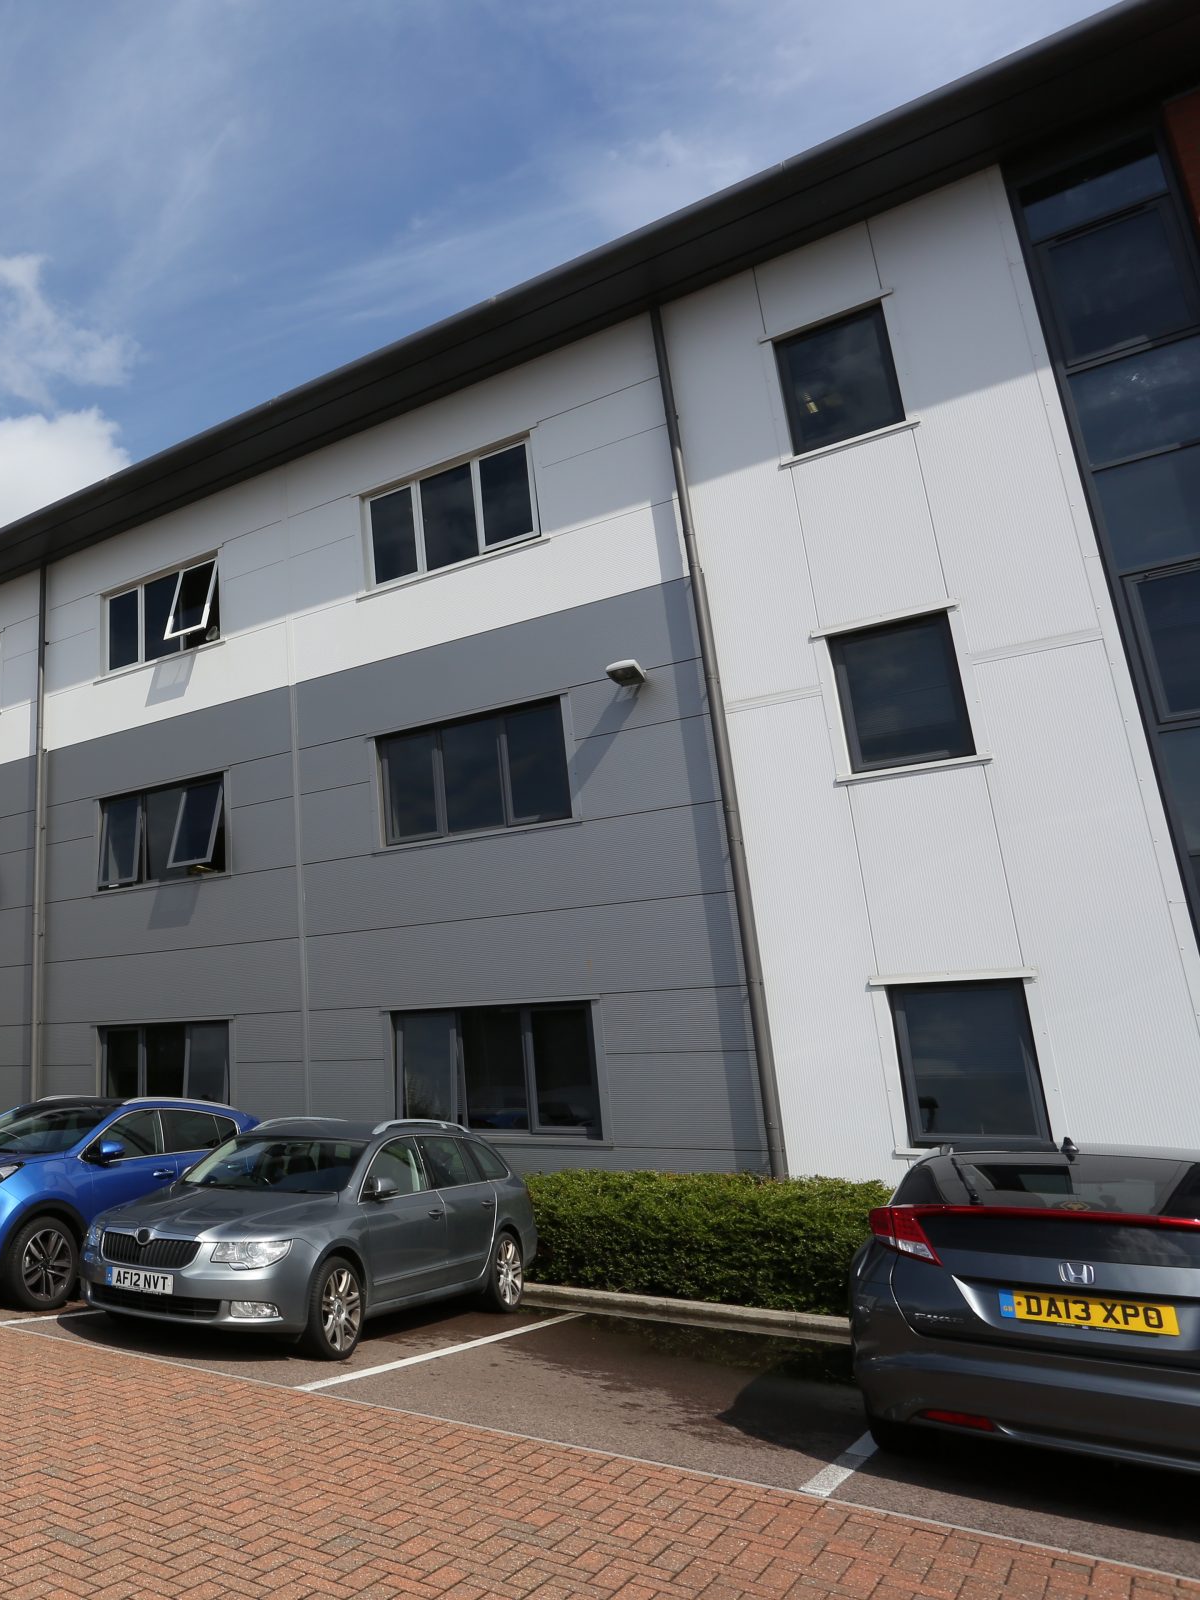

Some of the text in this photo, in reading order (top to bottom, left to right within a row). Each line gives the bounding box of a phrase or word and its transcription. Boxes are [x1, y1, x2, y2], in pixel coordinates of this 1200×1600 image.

[115, 1270, 168, 1291] AF12 NVT
[1023, 1295, 1164, 1329] DA13 XPO
